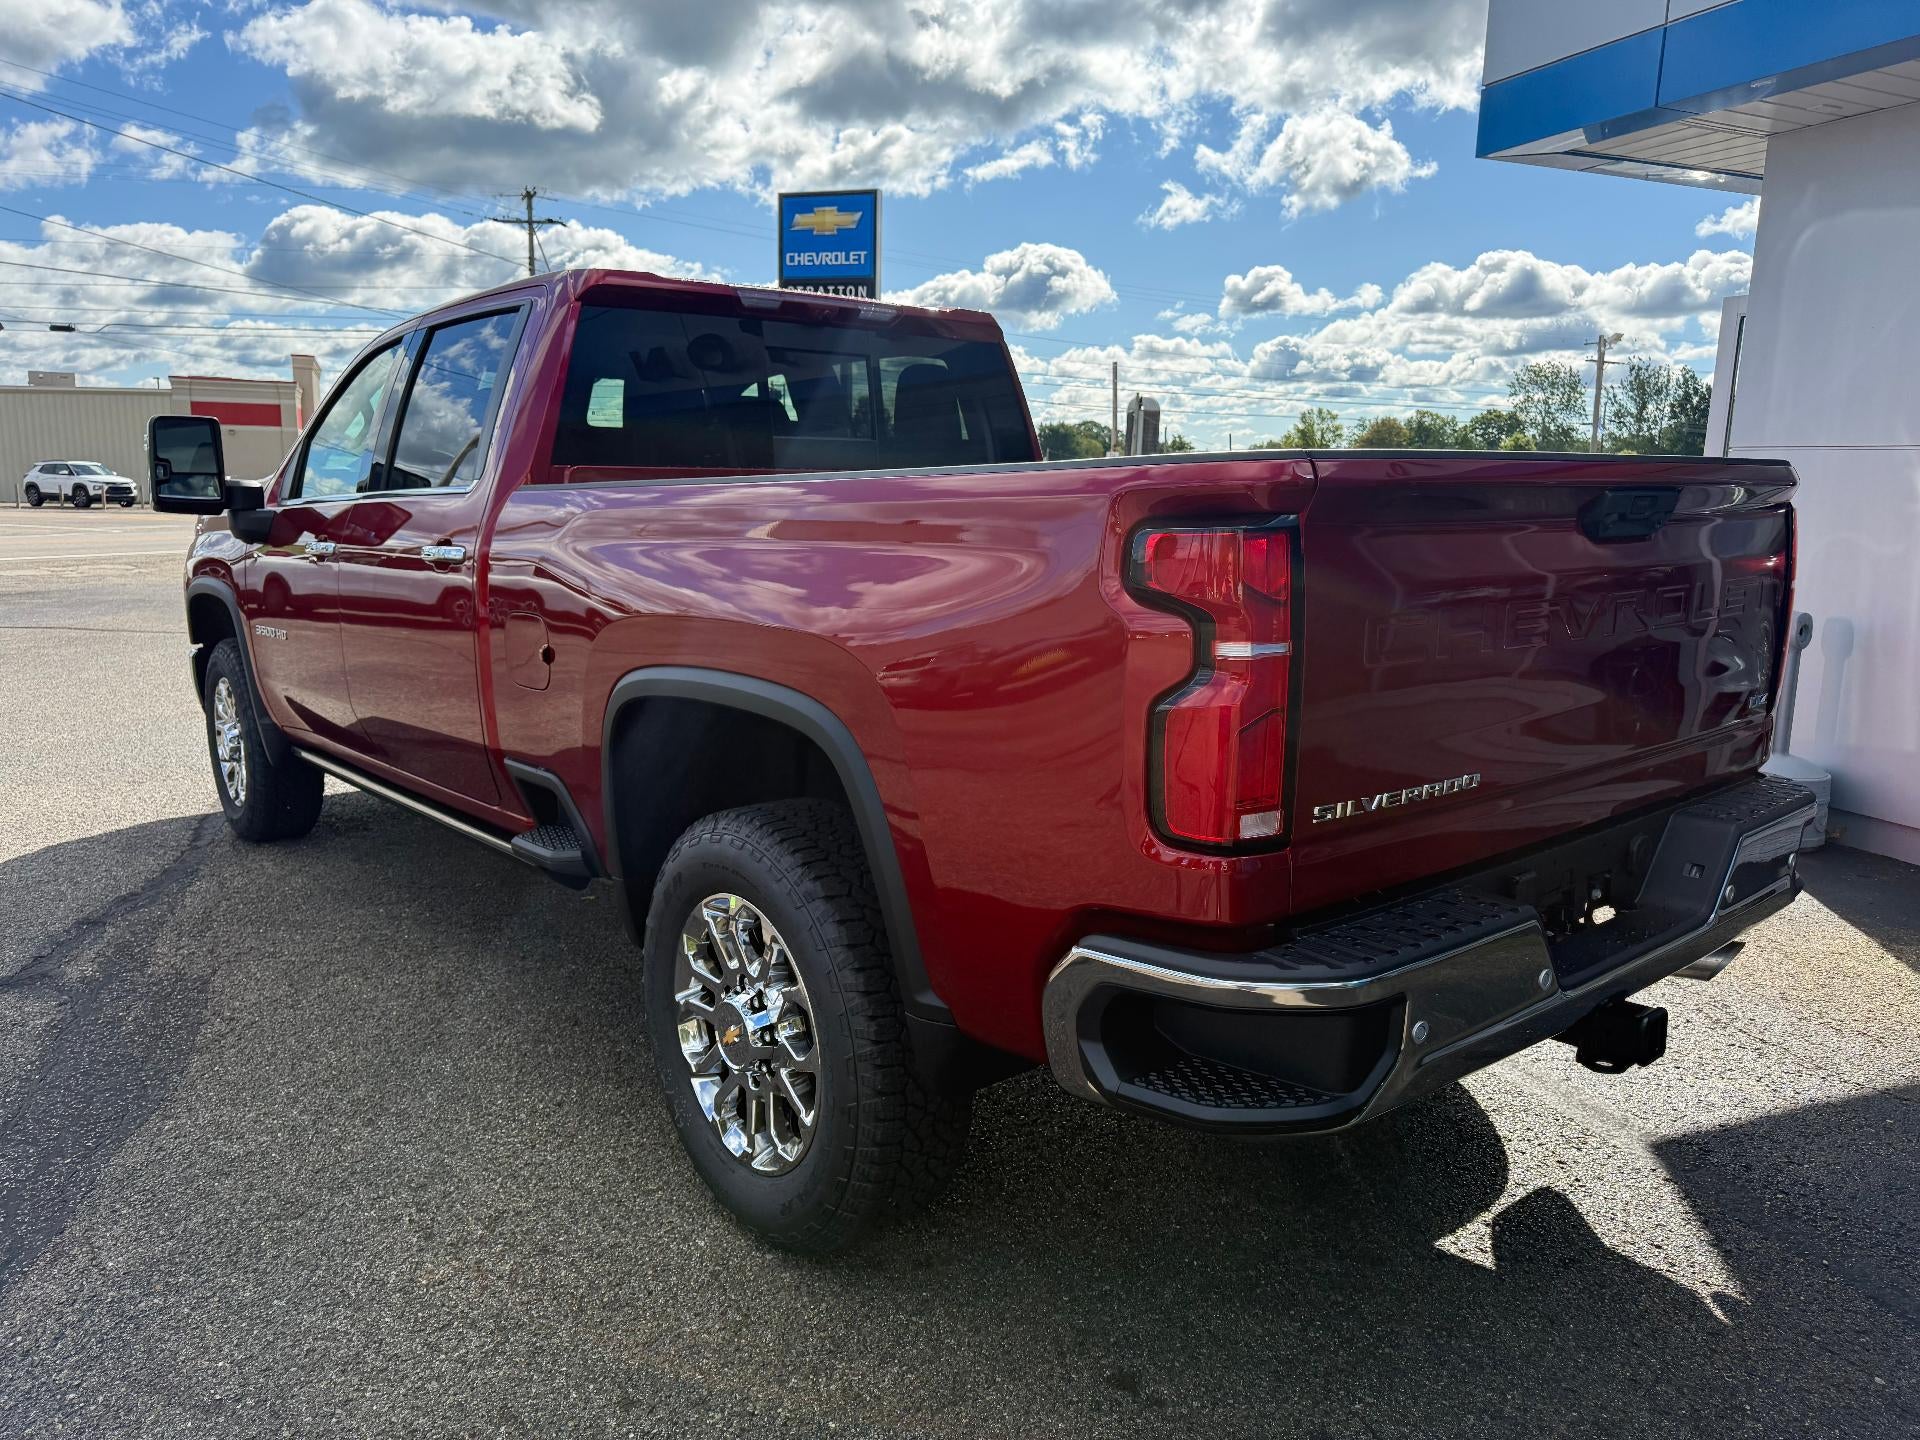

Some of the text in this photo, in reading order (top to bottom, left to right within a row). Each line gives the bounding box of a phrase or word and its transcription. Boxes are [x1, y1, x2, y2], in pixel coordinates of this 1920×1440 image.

[786, 251, 868, 266] CHEVROLET
[255, 624, 288, 640] 3500 HD
[1364, 575, 1779, 667] CHEVROLET
[1312, 773, 1480, 824] SILVERADO
